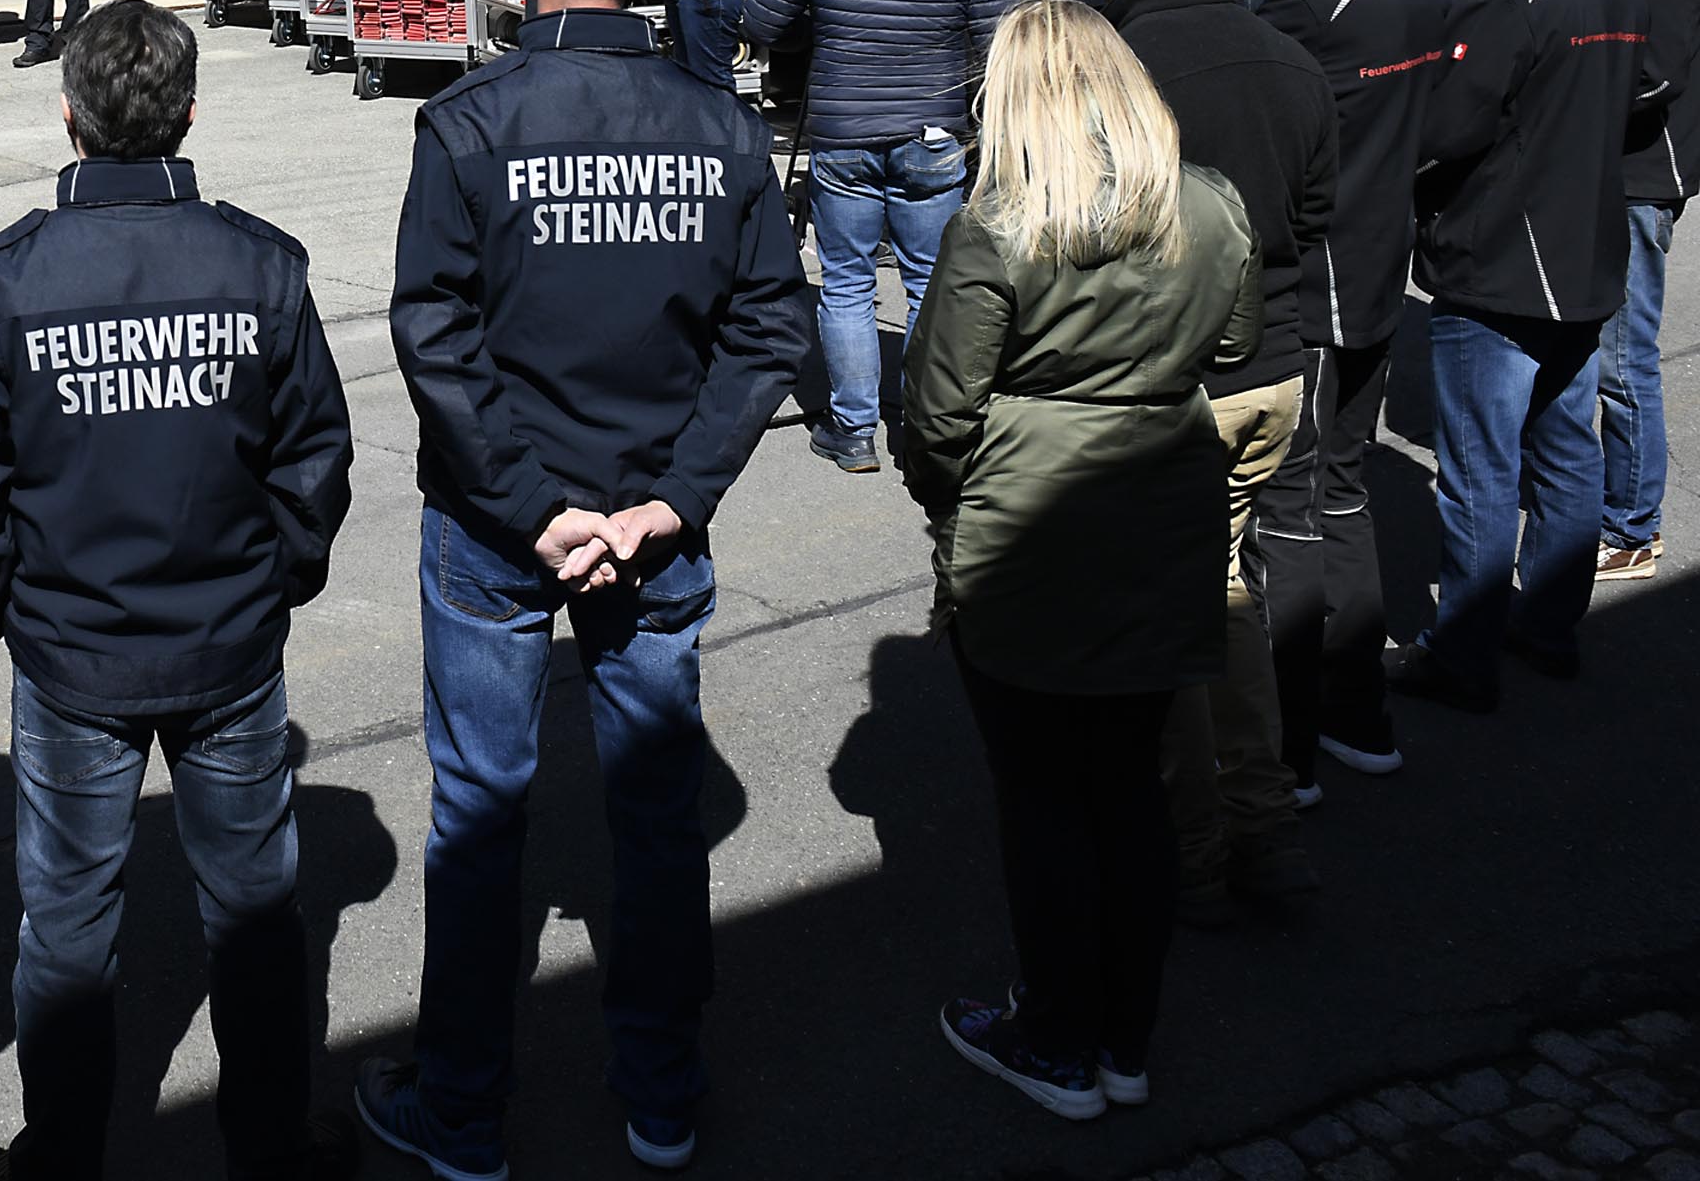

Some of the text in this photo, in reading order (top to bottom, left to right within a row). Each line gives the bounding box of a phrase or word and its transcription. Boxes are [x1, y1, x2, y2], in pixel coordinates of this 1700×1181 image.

[506, 154, 727, 202] FEUERWEHR
[532, 201, 705, 246] STEINACH
[25, 312, 260, 372] FEUERWEHR
[56, 361, 234, 416] STEINACH
